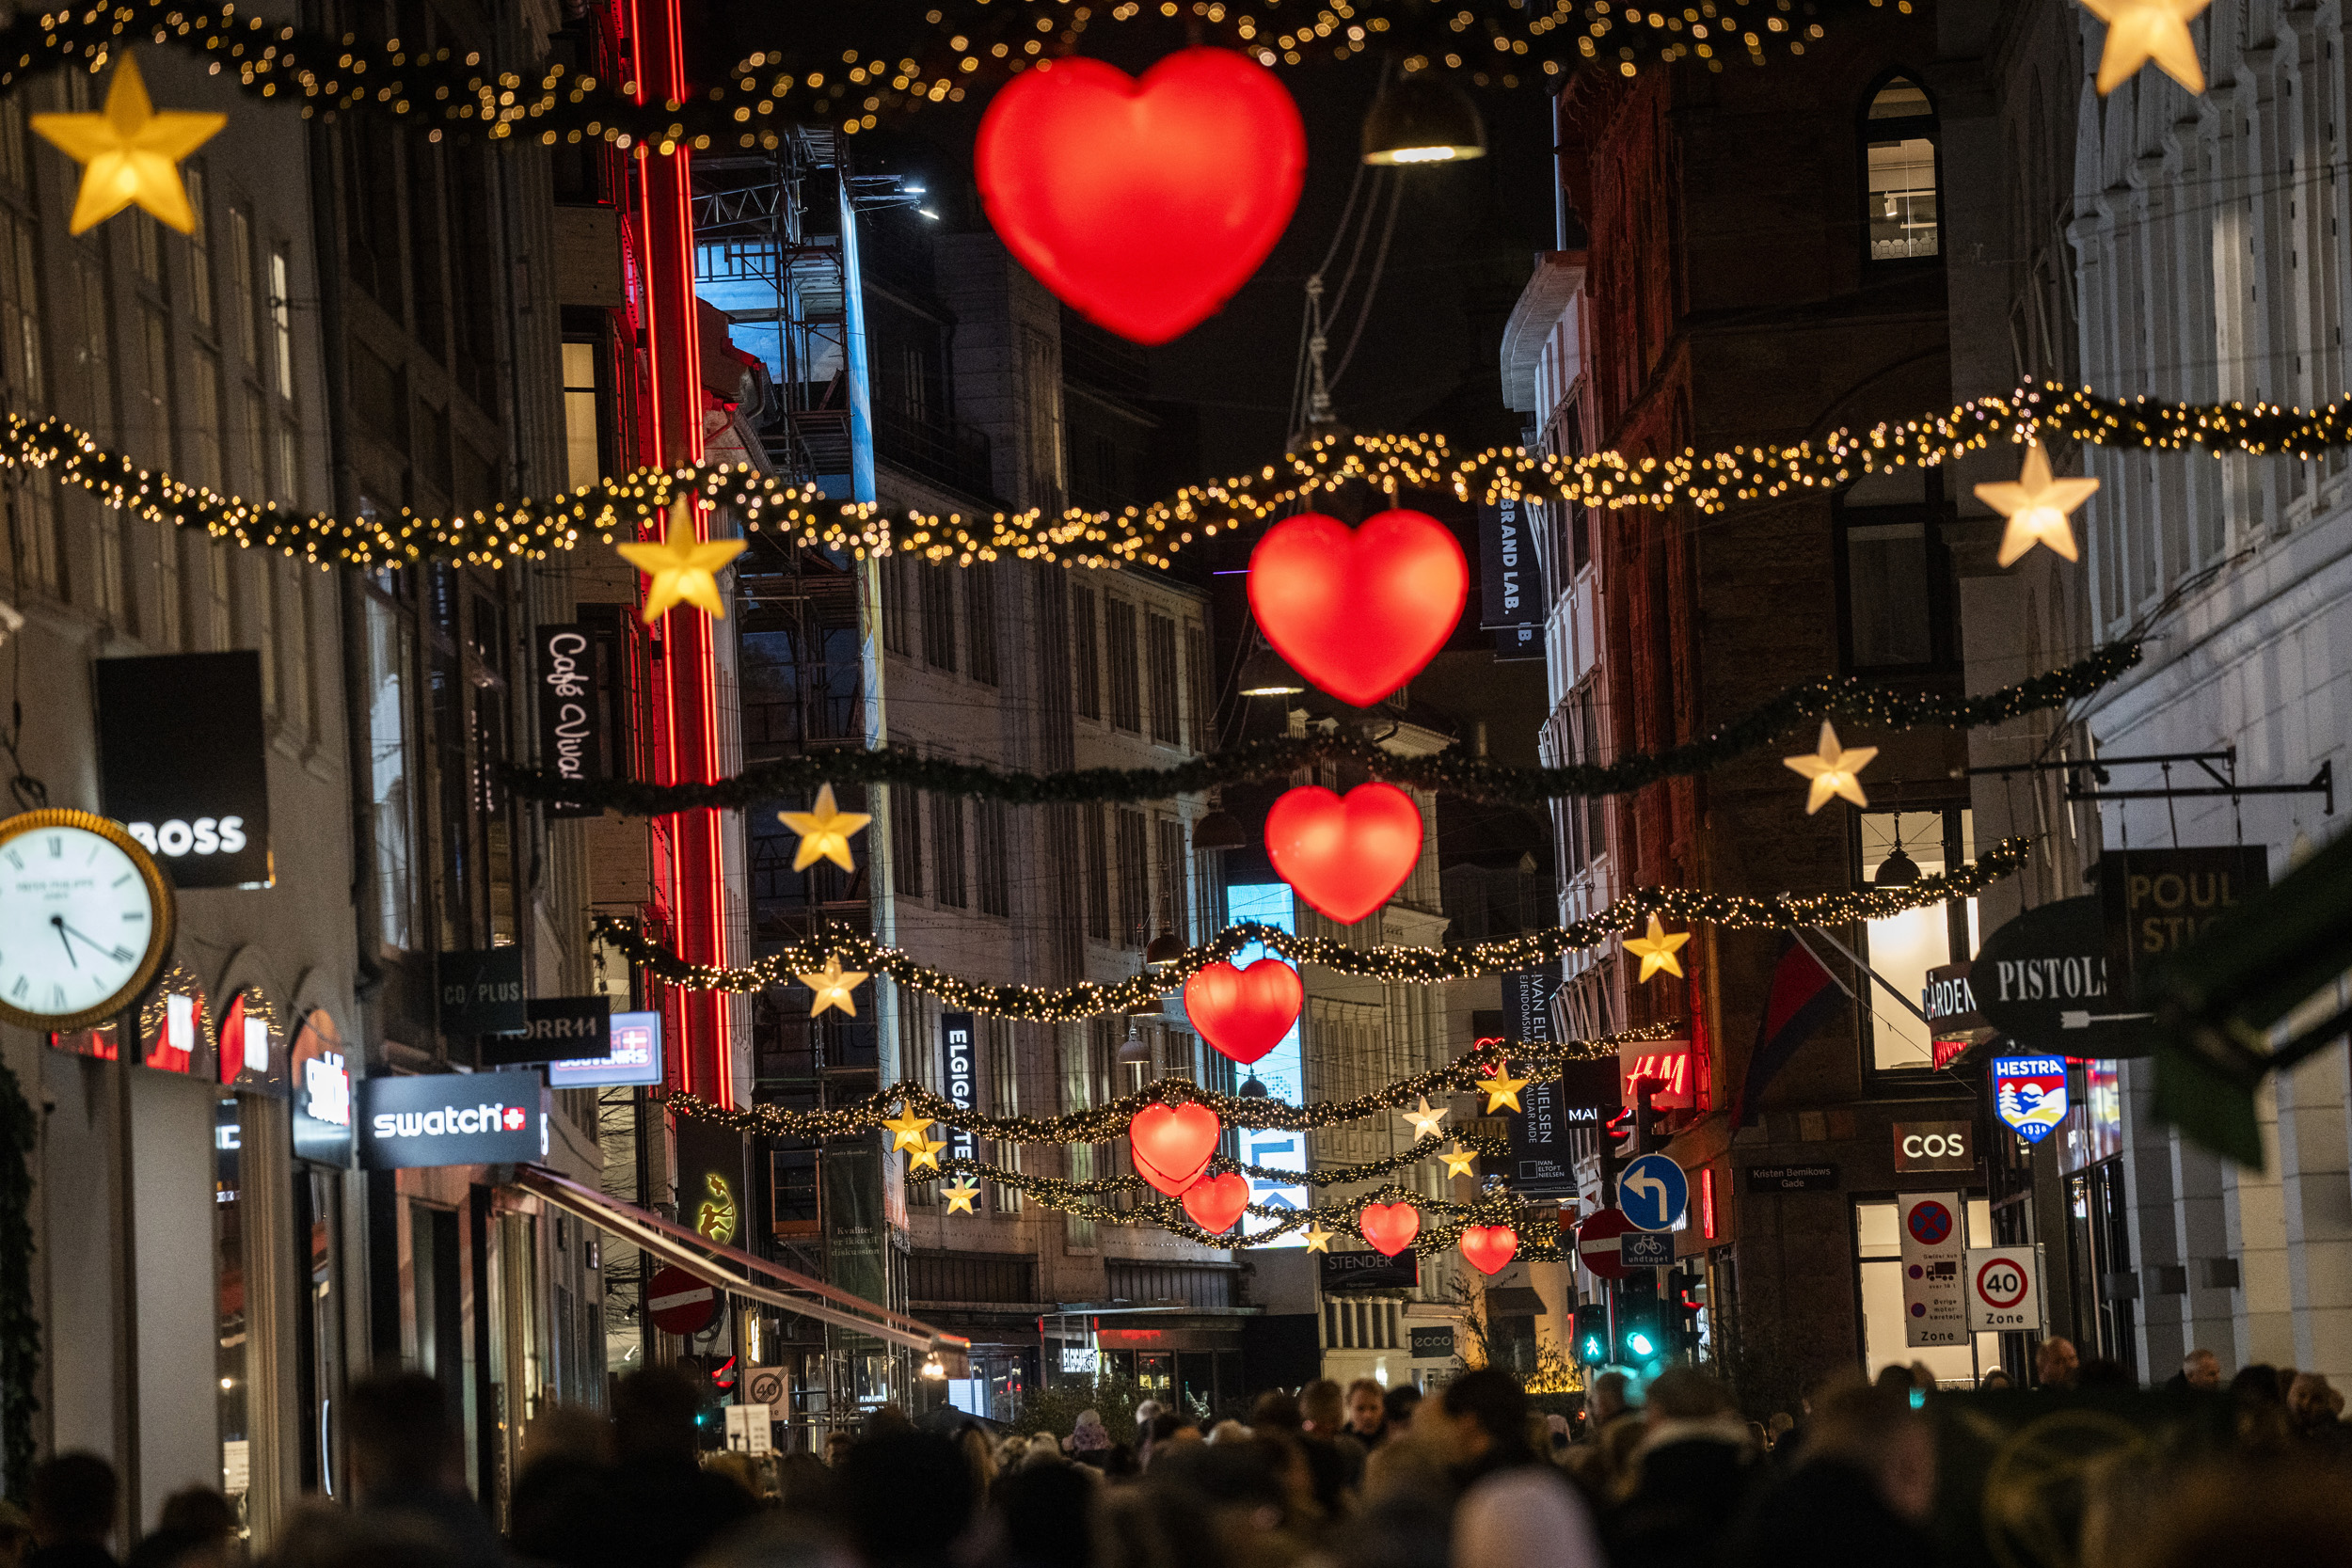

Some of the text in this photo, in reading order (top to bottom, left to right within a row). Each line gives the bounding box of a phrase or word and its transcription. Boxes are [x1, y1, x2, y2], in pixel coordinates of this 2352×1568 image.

[1500, 499, 1519, 615] BRAND LAB.
[547, 632, 589, 698] Café
[128, 816, 246, 857] BOSS
[2128, 871, 2239, 910] POUL
[1532, 974, 1546, 1012] IVAN
[496, 1017, 597, 1040] ORR11
[1996, 1059, 2064, 1076] HESTRA
[1536, 1081, 1552, 1144] NIELSEN
[373, 1103, 503, 1140] swatch
[1901, 1133, 1964, 1158] COS
[1753, 1169, 1785, 1179] Kristen
[1781, 1179, 1805, 1188] Gade
[836, 1226, 874, 1235] Kvalitet
[845, 1236, 863, 1245] ikke
[866, 1235, 878, 1244] til
[831, 1246, 881, 1258] diskussion
[1628, 1255, 1669, 1264] undtaget
[1328, 1255, 1394, 1270] STENDER
[1986, 1273, 2018, 1293] 40
[1933, 1298, 1957, 1307] Øvrige
[1930, 1313, 1963, 1322] køretøjer
[1986, 1312, 2024, 1324] Zone
[1413, 1336, 1452, 1348] ecco
[1921, 1331, 1954, 1341] Zone
